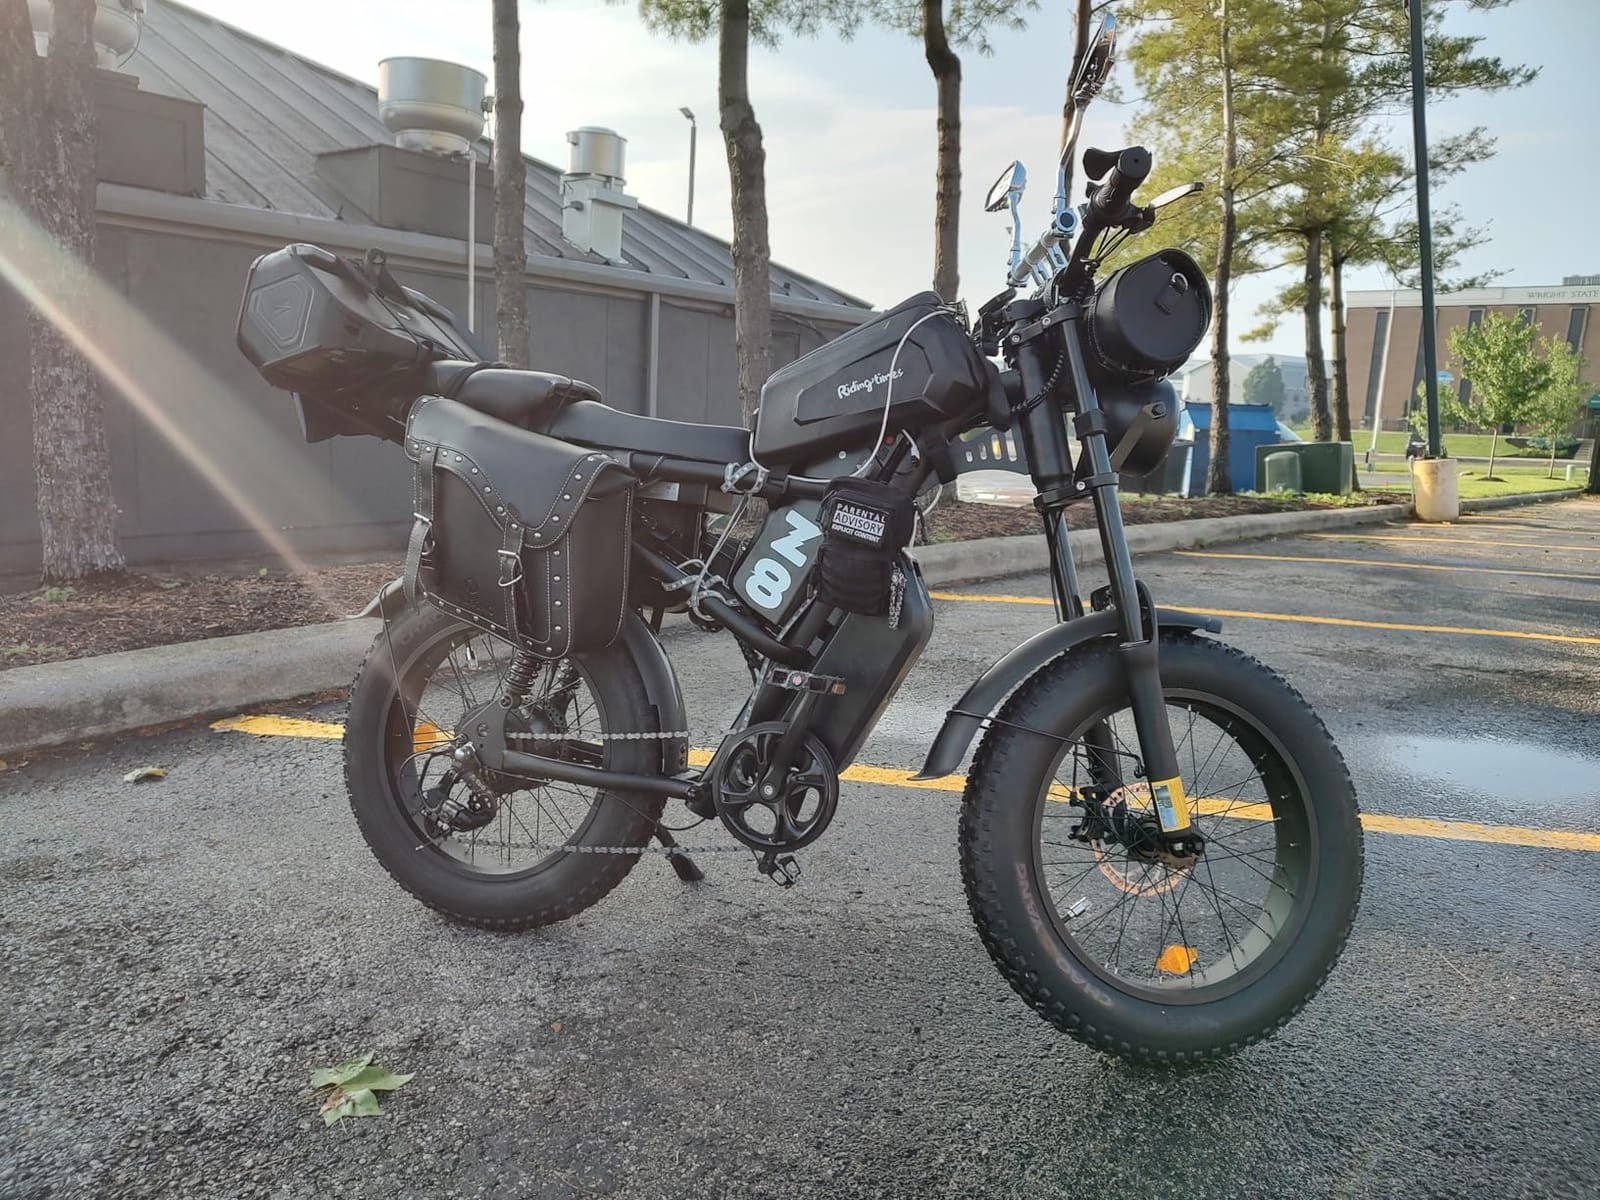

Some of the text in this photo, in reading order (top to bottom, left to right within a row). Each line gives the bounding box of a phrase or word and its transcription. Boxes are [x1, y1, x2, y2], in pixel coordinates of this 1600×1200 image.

[1571, 290, 1599, 298] STATE
[835, 512, 883, 534] ADVISORY
[837, 503, 886, 523] PARENTAL
[831, 523, 880, 543] EXPLICIT CONTENT
